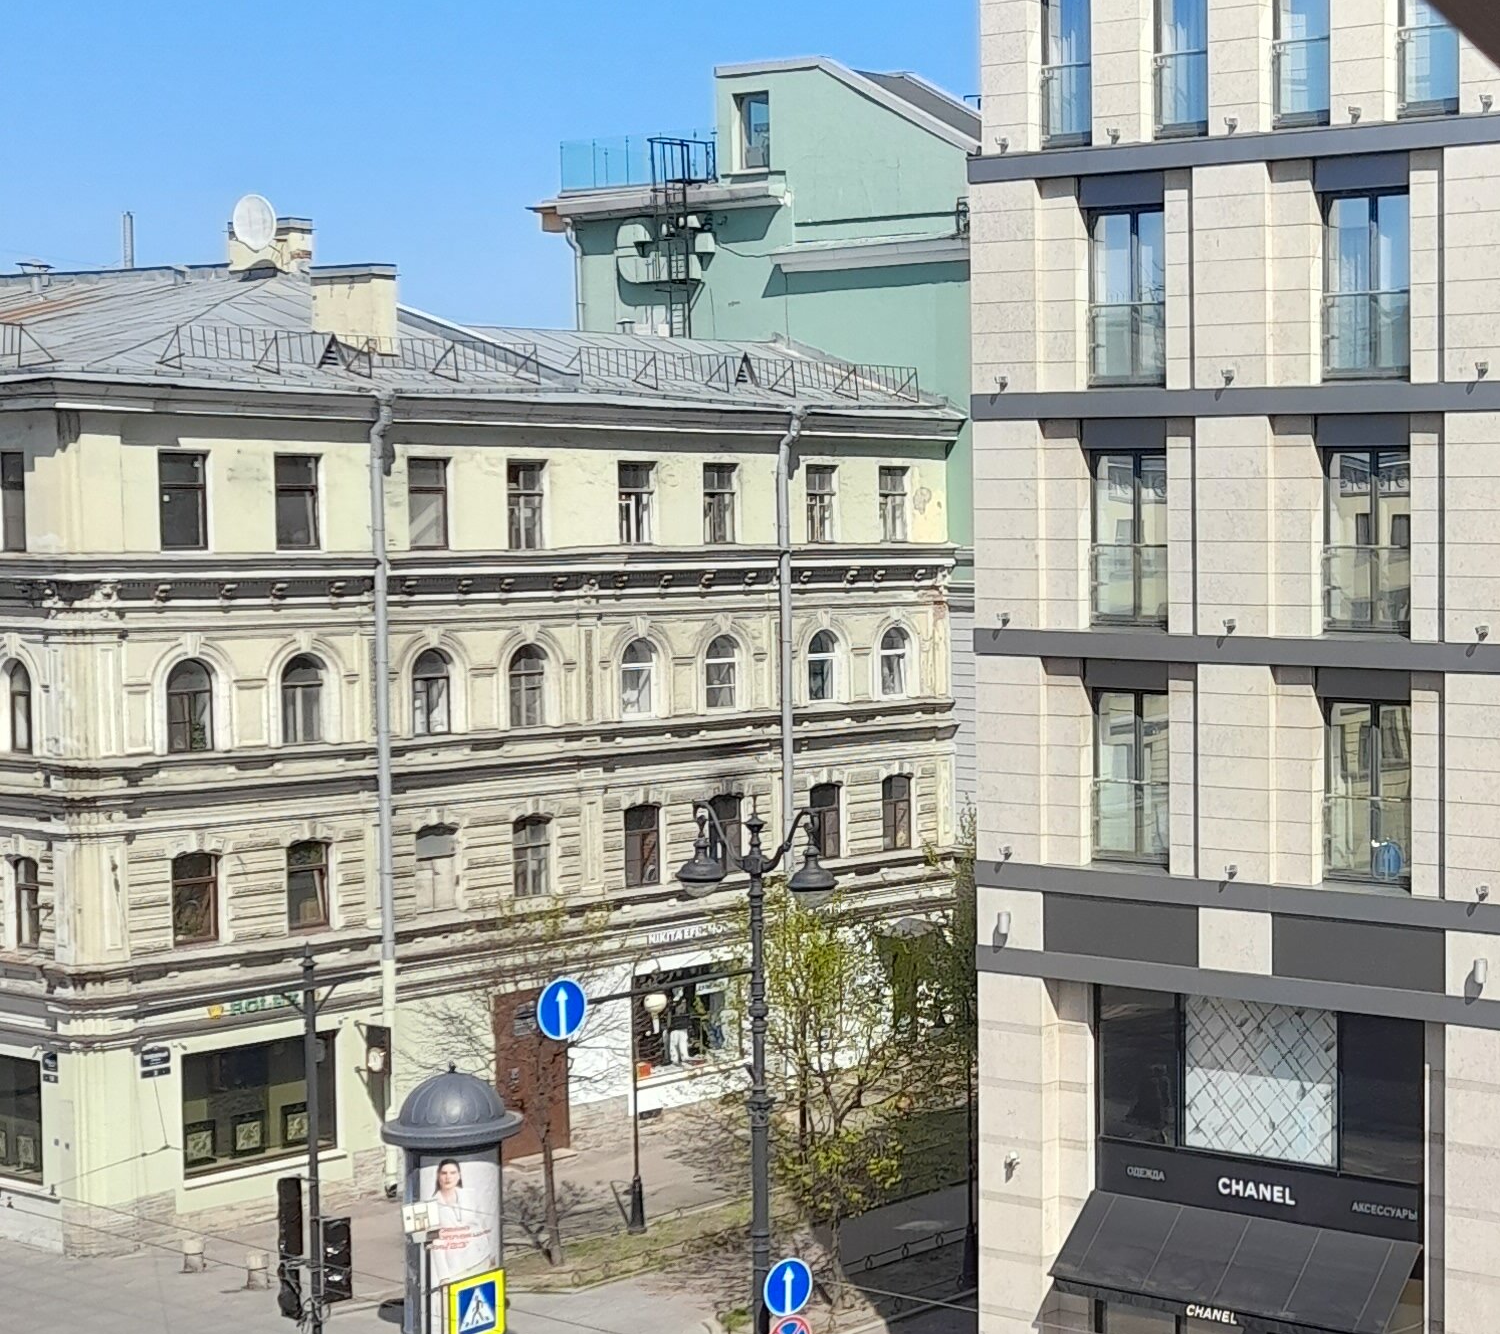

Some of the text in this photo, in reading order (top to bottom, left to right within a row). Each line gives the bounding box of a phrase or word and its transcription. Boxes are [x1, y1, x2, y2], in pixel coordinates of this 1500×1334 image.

[648, 929, 684, 945] NIKITA
[1127, 1166, 1165, 1181] ОДЕЖДА
[1217, 1176, 1296, 1206] CHANEL
[1351, 1201, 1418, 1221] АКСЕССУАРЫ
[1186, 1304, 1237, 1325] CHANEL
